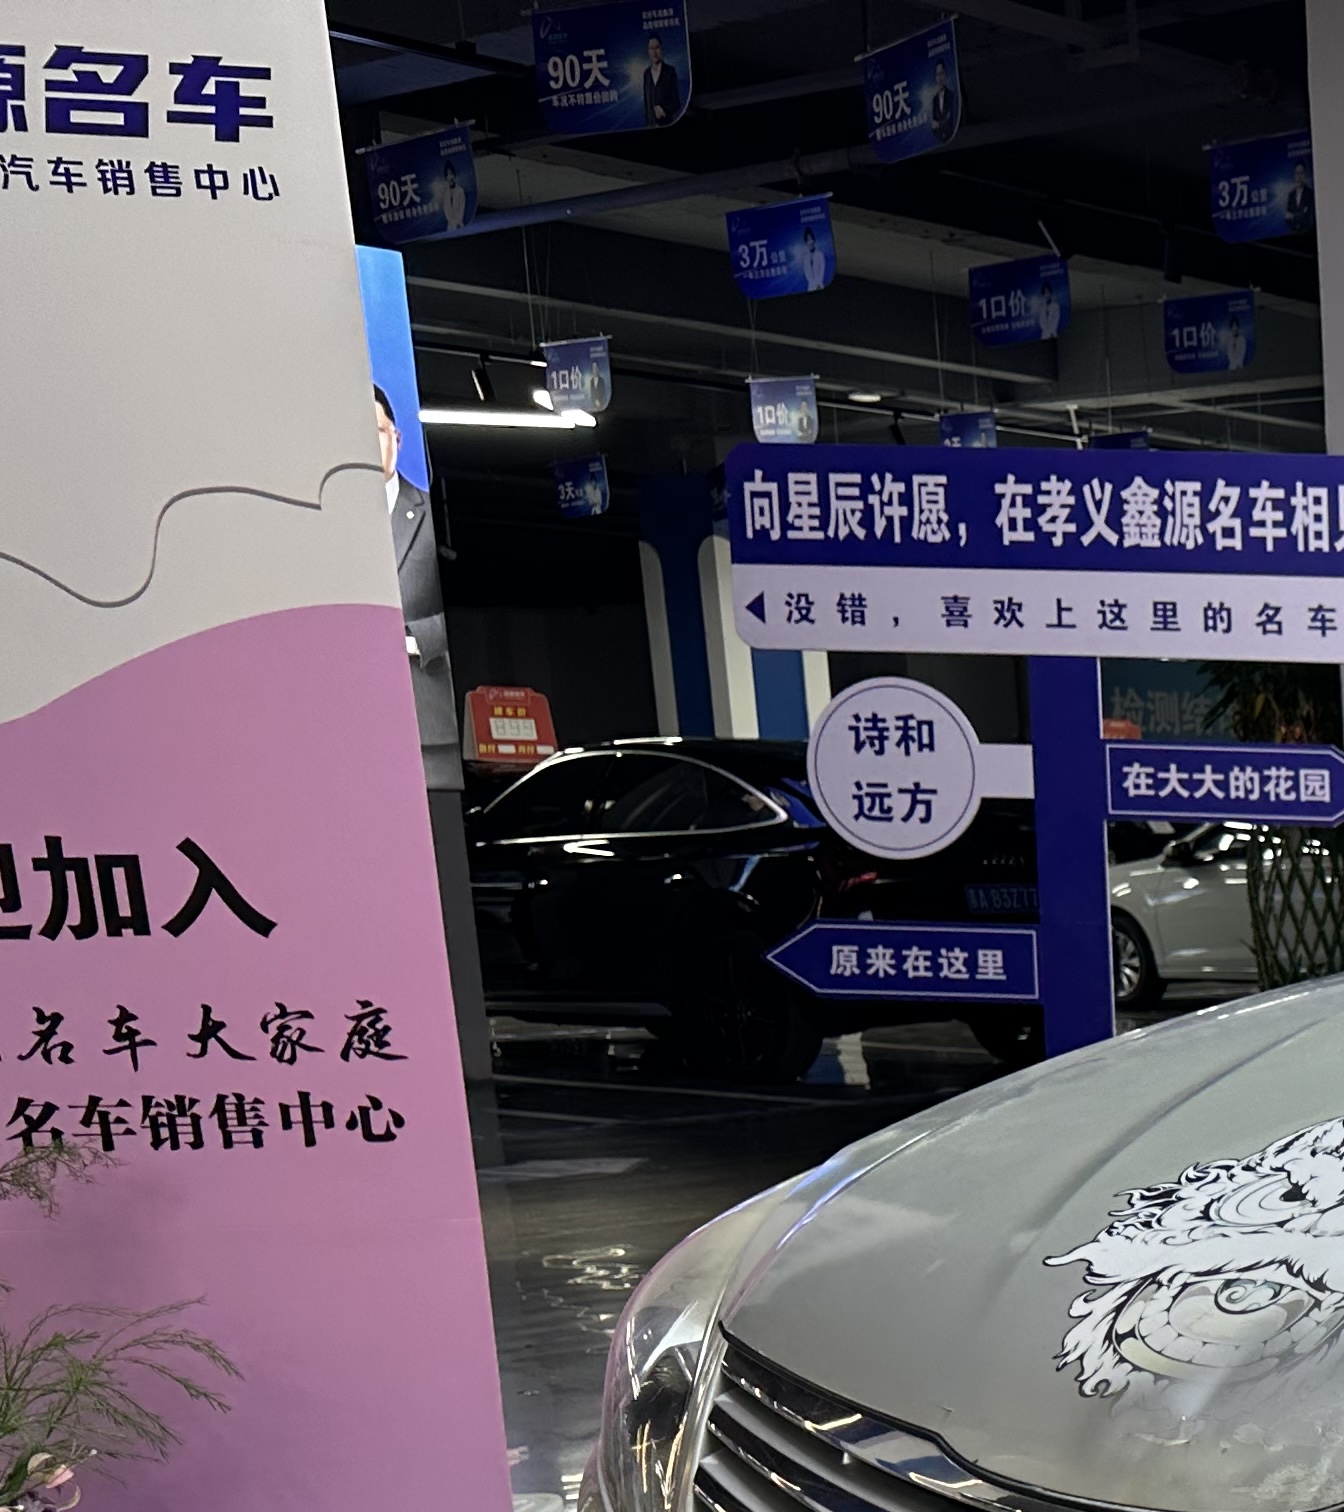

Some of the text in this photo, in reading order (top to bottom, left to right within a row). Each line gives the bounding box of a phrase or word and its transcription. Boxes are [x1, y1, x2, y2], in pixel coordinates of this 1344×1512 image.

[547, 49, 611, 90] 90天
[0, 44, 274, 143] 名车
[872, 79, 913, 124] 90天
[0, 154, 280, 201] 汽车销售中心
[377, 174, 421, 210] 90天
[847, 711, 936, 758] 诗和
[851, 779, 939, 825] 远方
[1122, 761, 1332, 804] 在大大的花园
[829, 944, 1008, 982] 原来在这里
[17, 999, 409, 1072] 名车大家庭
[6, 1090, 405, 1152] 名车销售中心
